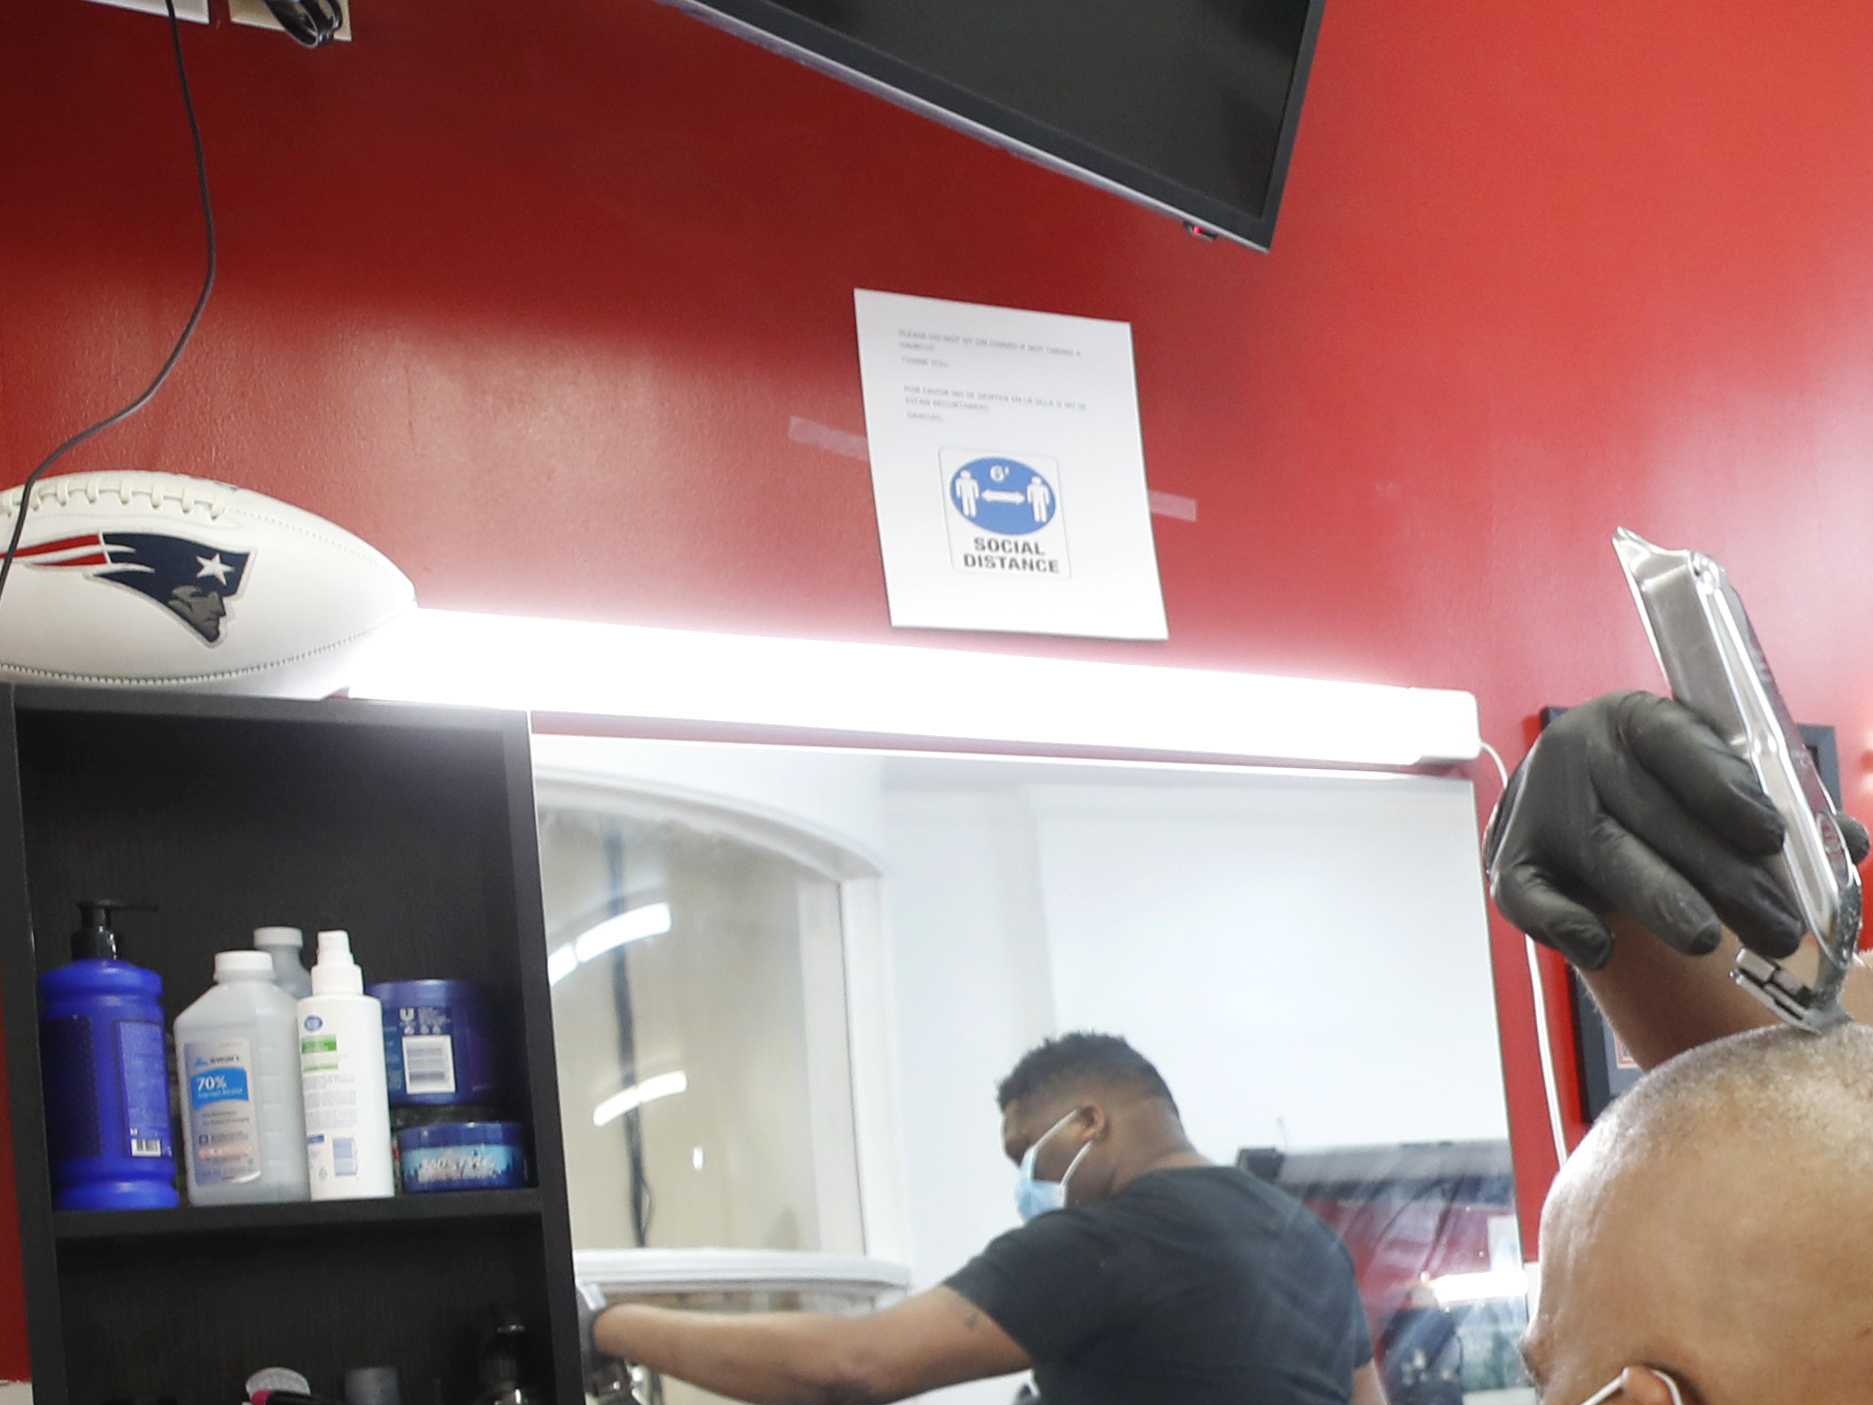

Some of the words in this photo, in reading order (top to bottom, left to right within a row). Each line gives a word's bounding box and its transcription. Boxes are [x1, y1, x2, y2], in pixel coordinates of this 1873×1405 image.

[974, 537, 1045, 556] SOCIAL
[963, 553, 1059, 573] DISTANCE
[197, 1075, 227, 1092] 70%
